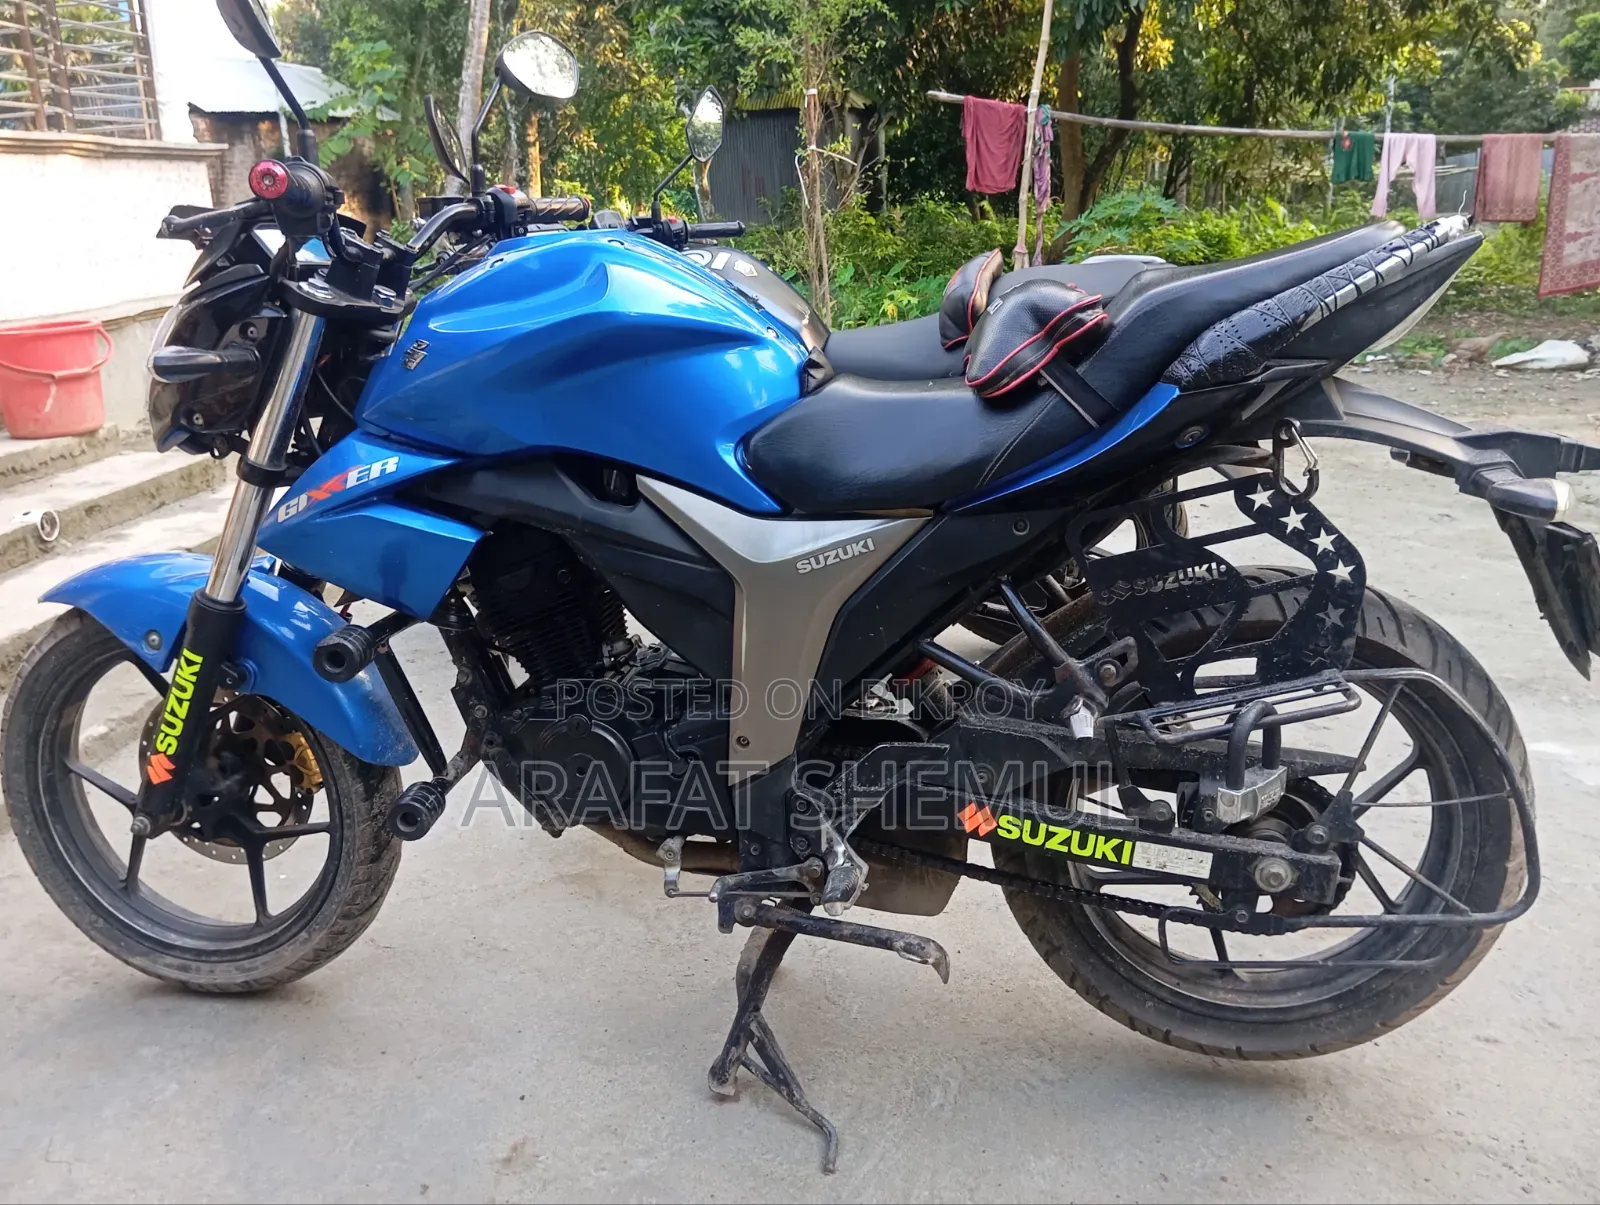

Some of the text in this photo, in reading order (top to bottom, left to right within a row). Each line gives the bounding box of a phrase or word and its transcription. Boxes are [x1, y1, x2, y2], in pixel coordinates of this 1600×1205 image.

[796, 537, 876, 574] SUZUKI
[1132, 561, 1219, 596] SUZUKI
[155, 647, 204, 756] SUZUKI
[996, 814, 1134, 866] SUZUKI
